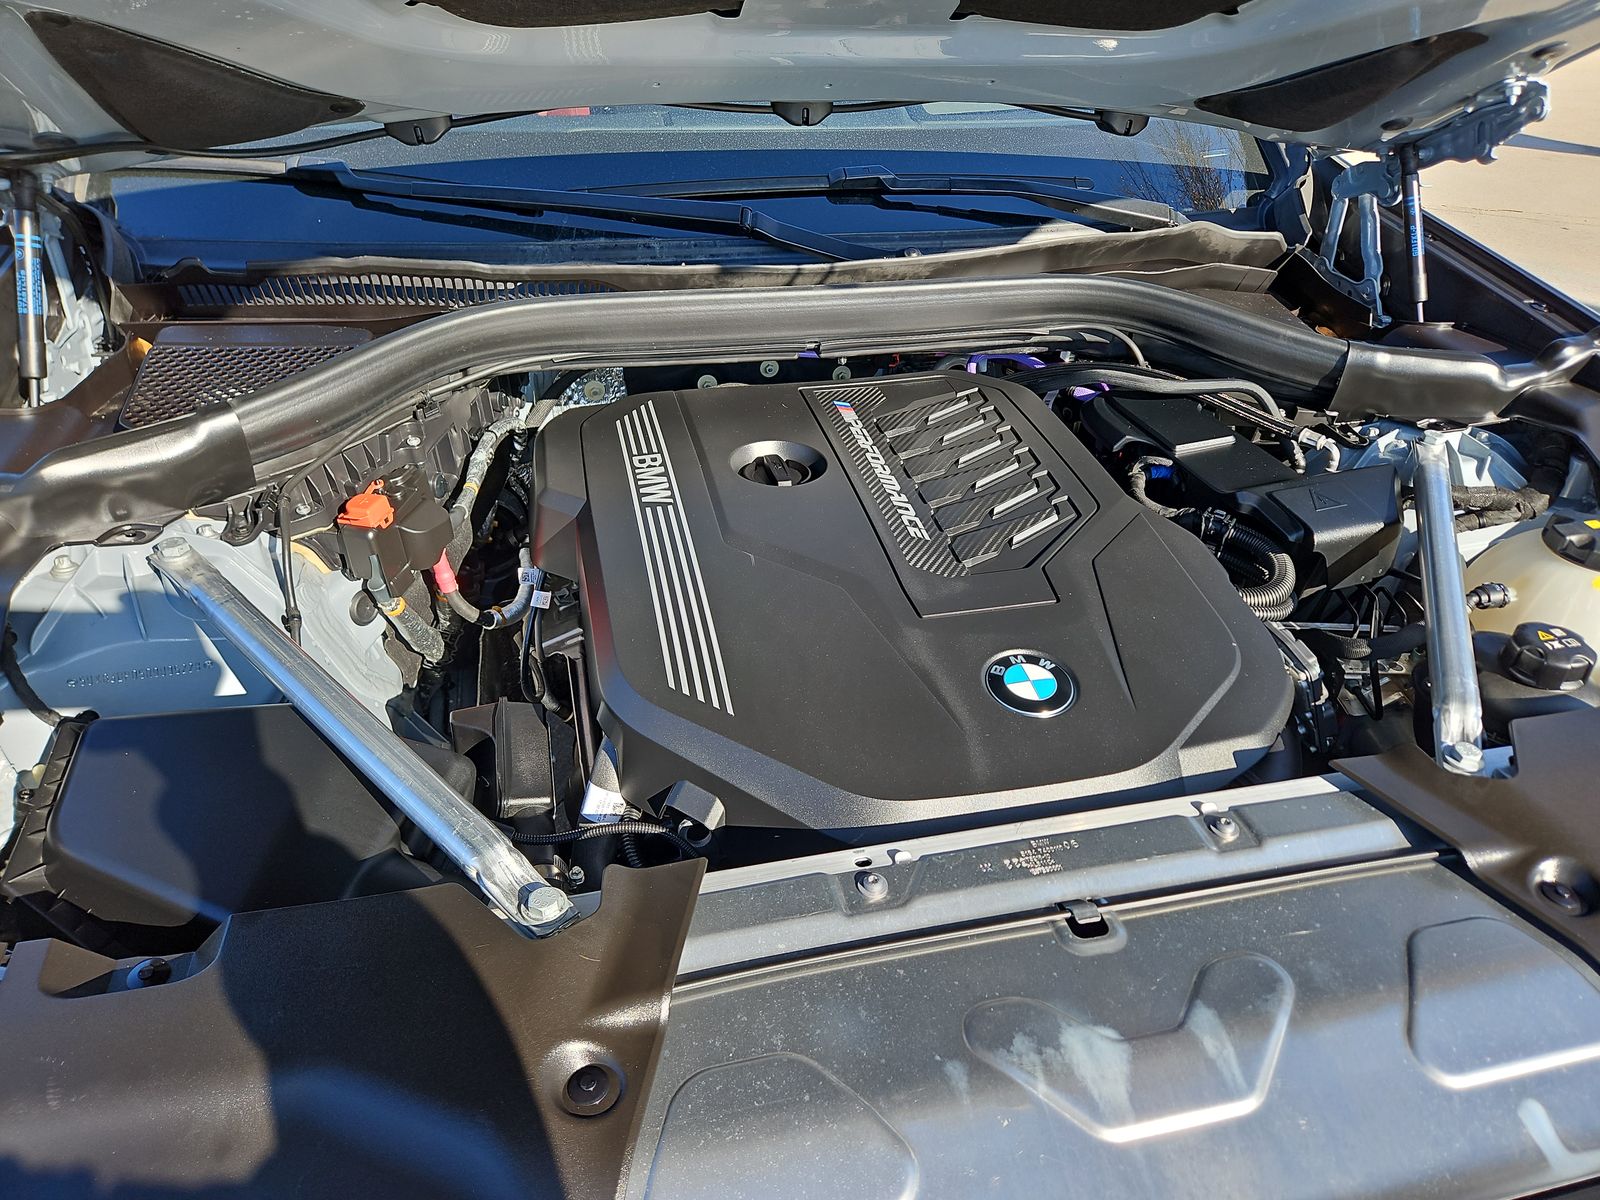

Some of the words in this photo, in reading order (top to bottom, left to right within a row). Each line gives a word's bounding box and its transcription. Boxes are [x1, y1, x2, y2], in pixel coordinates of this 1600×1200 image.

[632, 453, 674, 504] BMW
[849, 418, 931, 541] PERFORMANCE
[990, 655, 1055, 676] BMW
